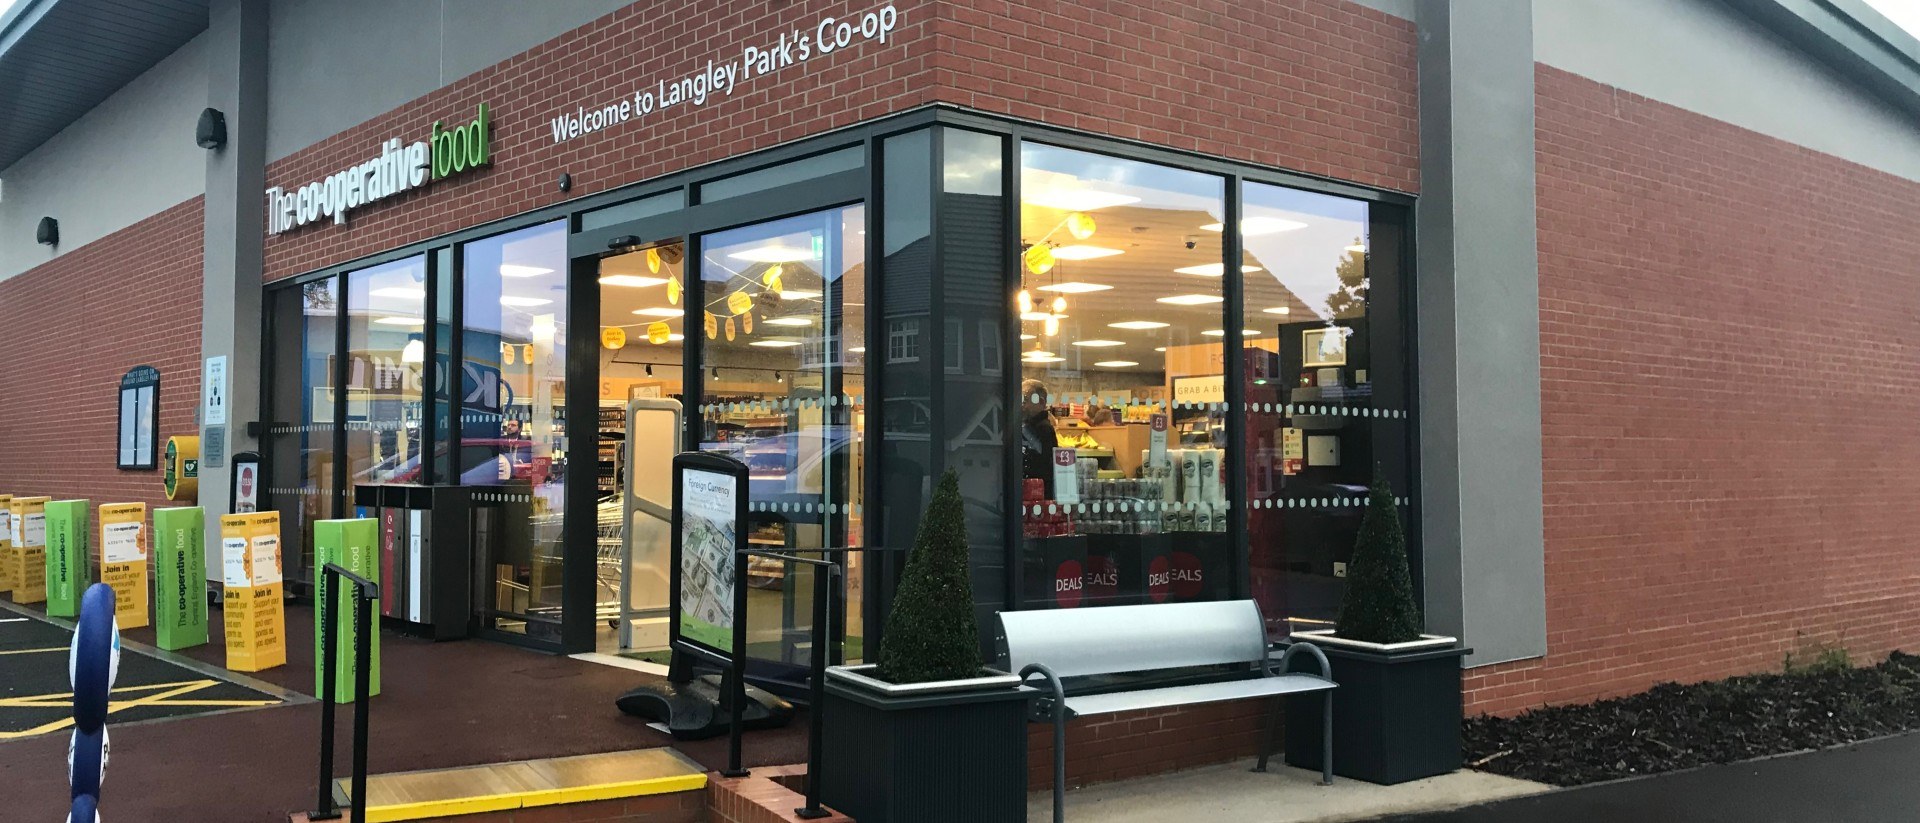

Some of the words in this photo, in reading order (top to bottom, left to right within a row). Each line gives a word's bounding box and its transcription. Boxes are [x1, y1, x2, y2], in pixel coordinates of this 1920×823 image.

[552, 100, 629, 143] Welcome
[635, 91, 653, 116] to
[659, 60, 738, 106] Langley
[744, 29, 810, 80] Park's
[816, 4, 897, 53] Co-op
[266, 186, 297, 236] The
[296, 137, 430, 225] co-operative
[430, 102, 488, 180] food
[1178, 385, 1201, 395] GRAB
[1204, 385, 1209, 393] A
[1060, 450, 1070, 463] £3
[688, 478, 707, 492] Foreign
[708, 482, 730, 498] Currency
[175, 528, 185, 549] food
[59, 533, 67, 582] co-operative
[350, 546, 360, 573] food
[104, 565, 121, 573] Join
[122, 564, 130, 572] in
[1171, 568, 1202, 582] EALS
[176, 550, 187, 610] co-operative
[1056, 576, 1083, 592] DEALS
[1087, 571, 1118, 586] EALS
[1149, 570, 1170, 587] DEALS
[225, 590, 235, 599] Join
[253, 589, 266, 598] Join
[265, 587, 272, 596] in
[177, 611, 187, 628] The
